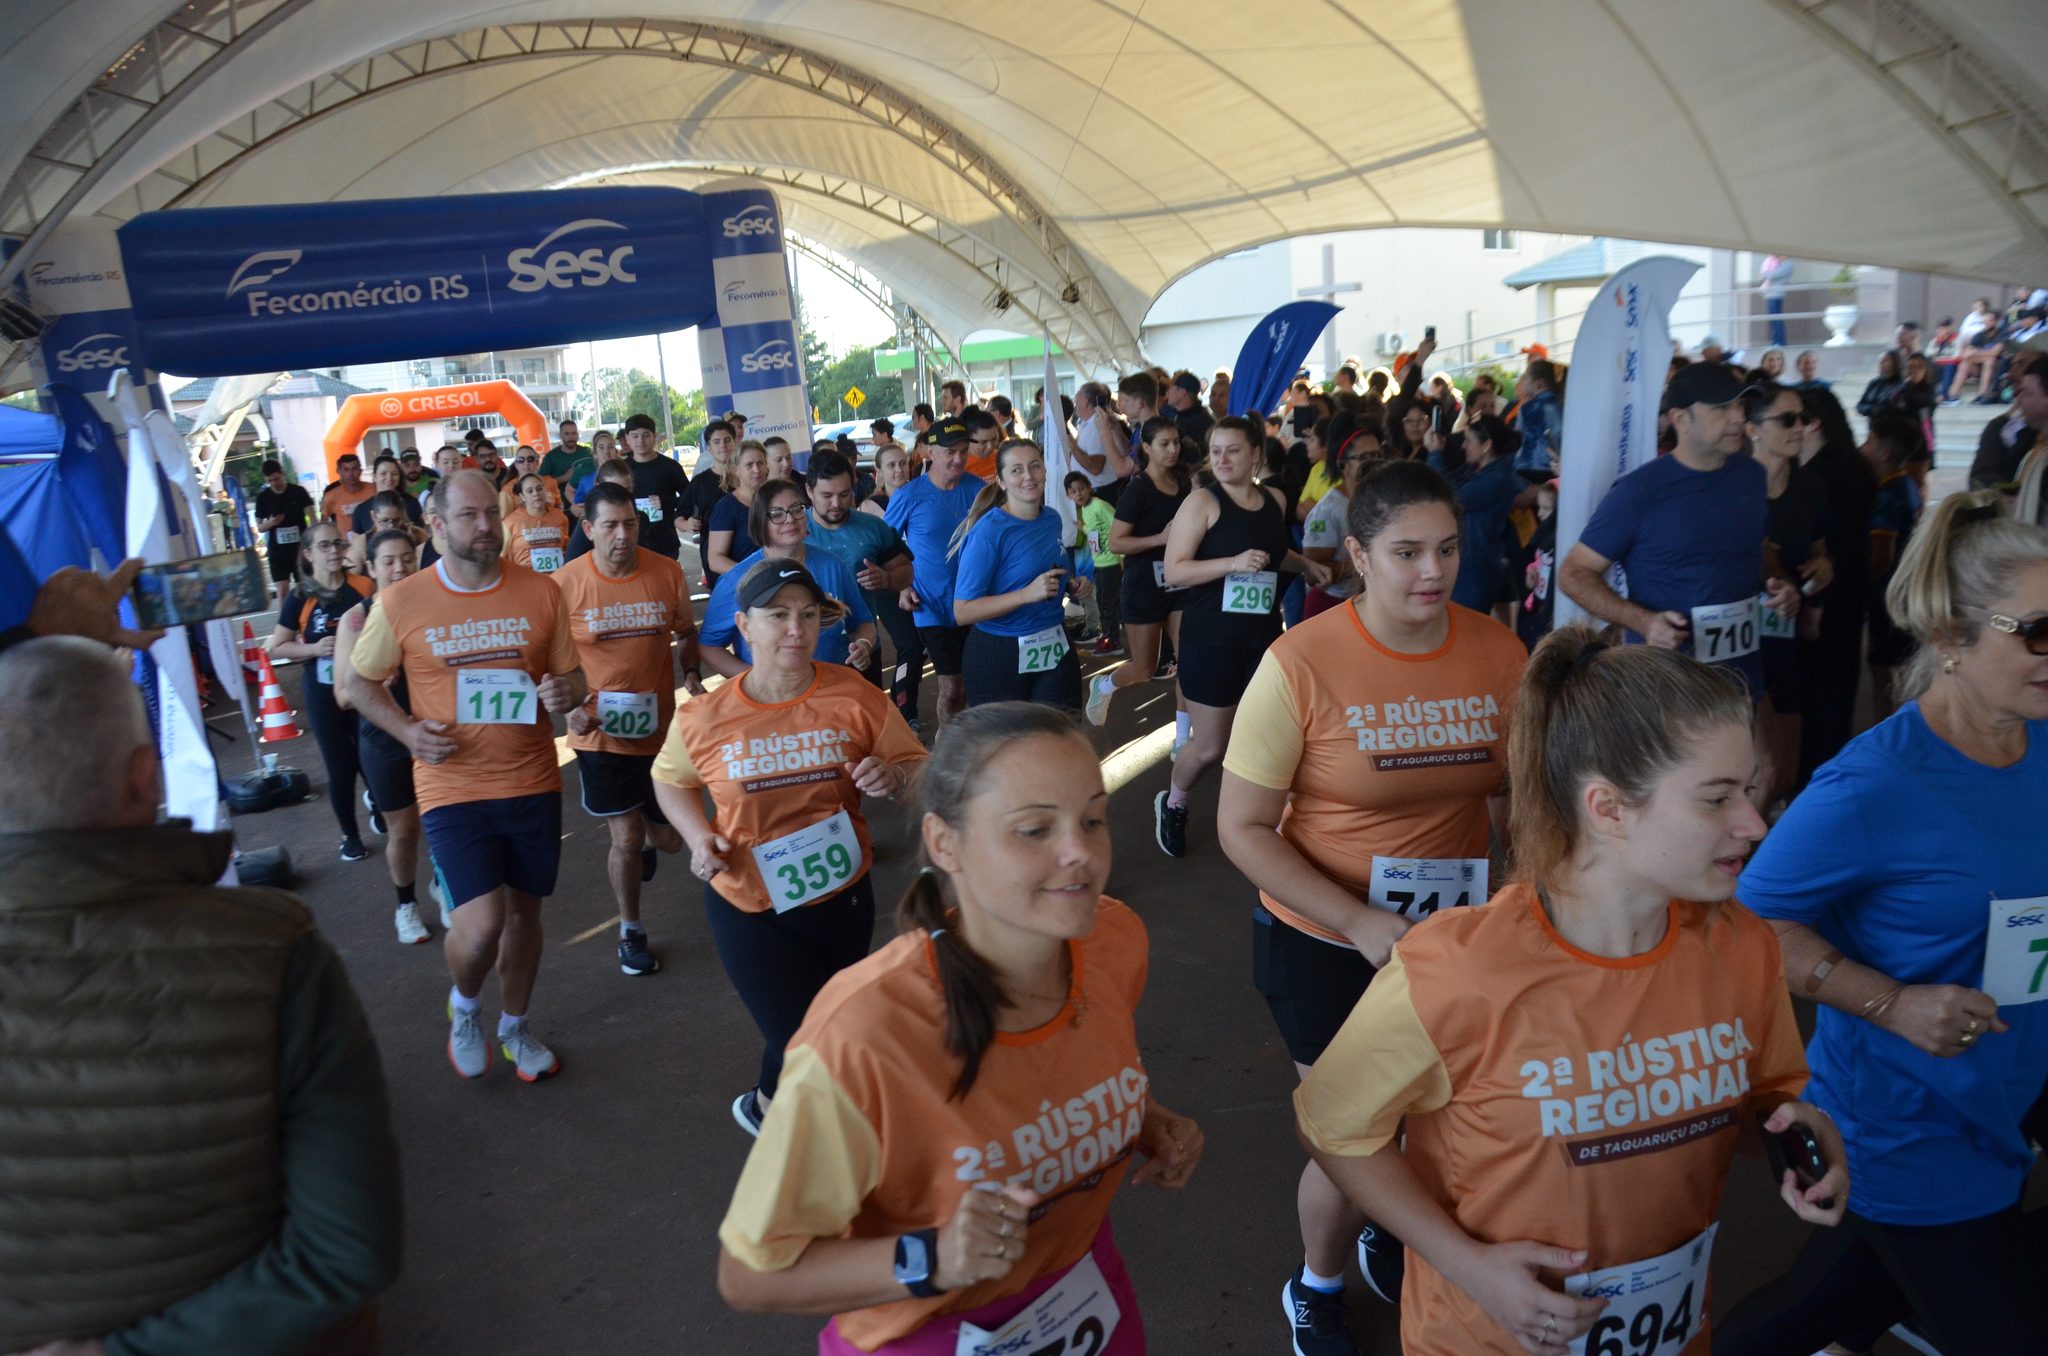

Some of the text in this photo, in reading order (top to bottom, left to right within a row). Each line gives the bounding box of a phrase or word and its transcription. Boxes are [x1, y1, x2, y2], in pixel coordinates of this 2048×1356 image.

[722, 212, 775, 238] Sesc
[507, 236, 636, 292] Sesc
[247, 274, 470, 317] Fecomércio RS
[728, 288, 778, 302] Fecomércio
[57, 341, 131, 373] Sesc
[741, 347, 793, 372] Sesc
[408, 391, 486, 413] CRESOL
[749, 421, 798, 435] Fecomércio
[536, 556, 560, 570] 281
[604, 601, 667, 618] RÚSTICA
[1230, 585, 1272, 610] 296
[450, 617, 531, 639] RÚSTICA
[588, 613, 666, 633] REGIONAL
[432, 631, 529, 656] REGIONAL
[1705, 619, 1753, 656] 710
[1026, 642, 1065, 669] 279
[469, 690, 527, 720] 117
[1345, 694, 1499, 728] 2ª RÚSTICA
[604, 710, 651, 735] 202
[1357, 720, 1499, 751] REGIONAL
[720, 728, 851, 762] 2ª RÚSTICA
[728, 745, 849, 780] REGIONAL
[1380, 759, 1393, 767] DE
[1456, 753, 1471, 761] DO
[1473, 752, 1489, 760] SUL
[764, 847, 788, 861] Sesc
[777, 843, 852, 901] 359
[1383, 867, 1413, 880] Sesc
[2006, 912, 2045, 928] Sesc
[1519, 1017, 1754, 1098] 2ª RÚSTICA
[1540, 1058, 1750, 1137] REGIONAL
[973, 1098, 1146, 1195] GIONA
[1579, 1146, 1600, 1159] DE
[1604, 1127, 1688, 1155] TAQUARUÇU
[1689, 1121, 1708, 1135] DO
[952, 1140, 1006, 1183] 2ª
[1585, 1280, 1695, 1356] 694
